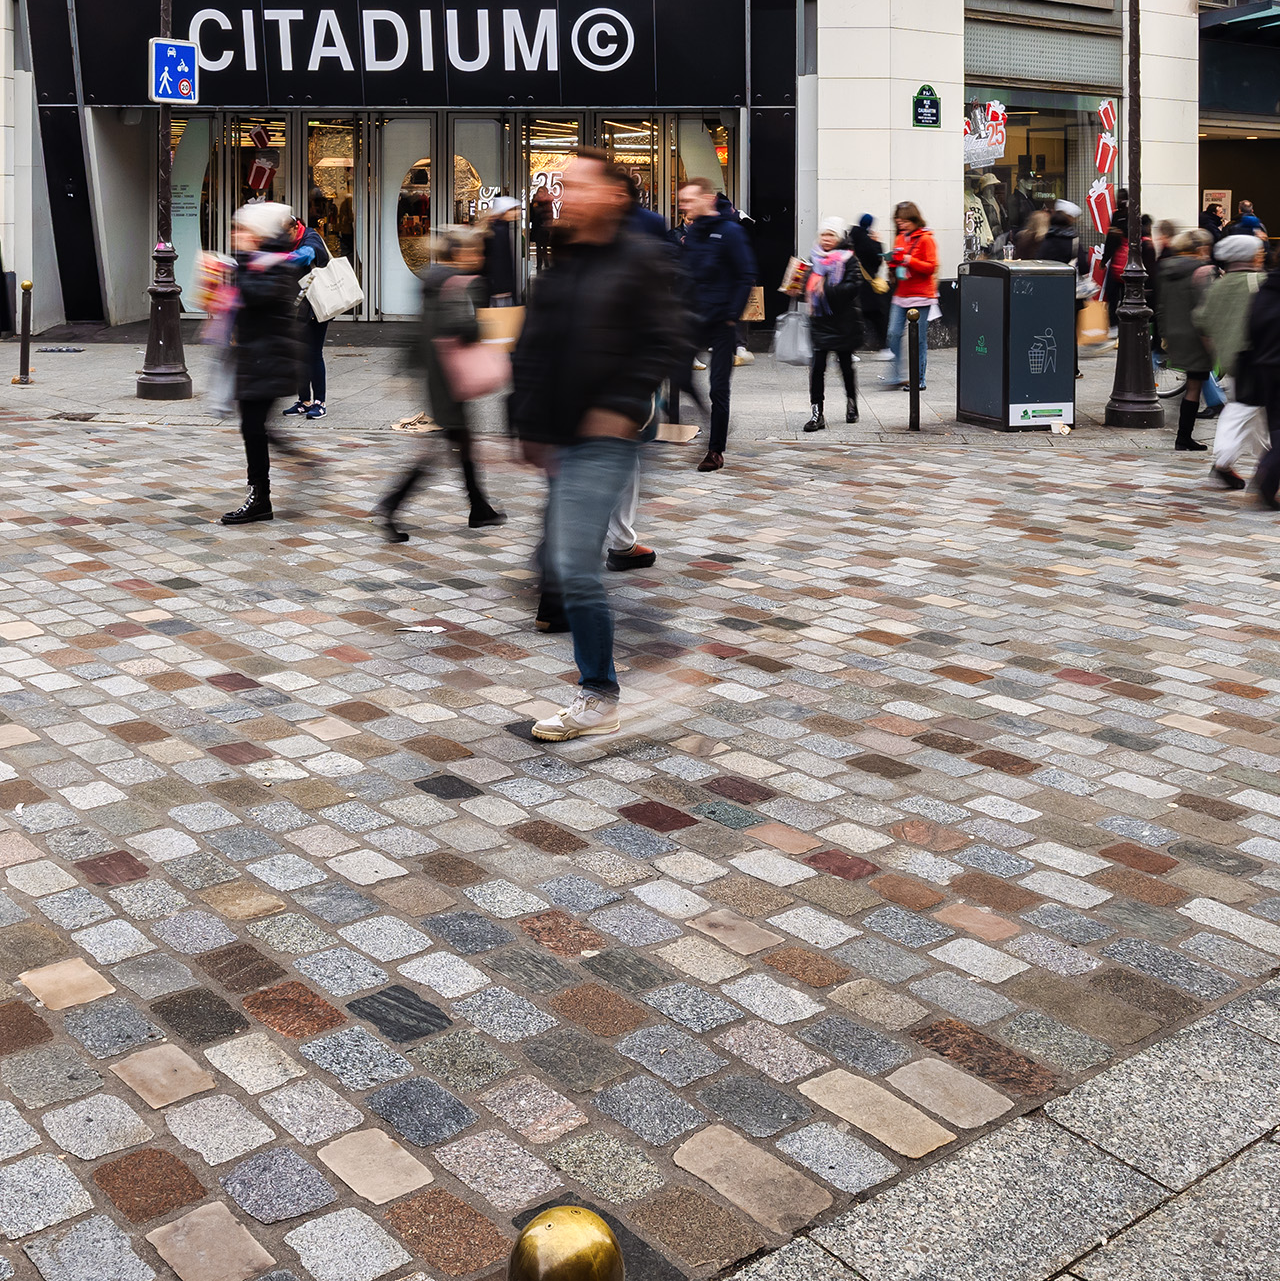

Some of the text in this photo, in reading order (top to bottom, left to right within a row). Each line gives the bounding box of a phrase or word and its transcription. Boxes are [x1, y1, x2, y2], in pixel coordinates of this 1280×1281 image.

[181, 84, 189, 92] 20
[986, 122, 1005, 147] 25
[966, 211, 975, 233] 5
